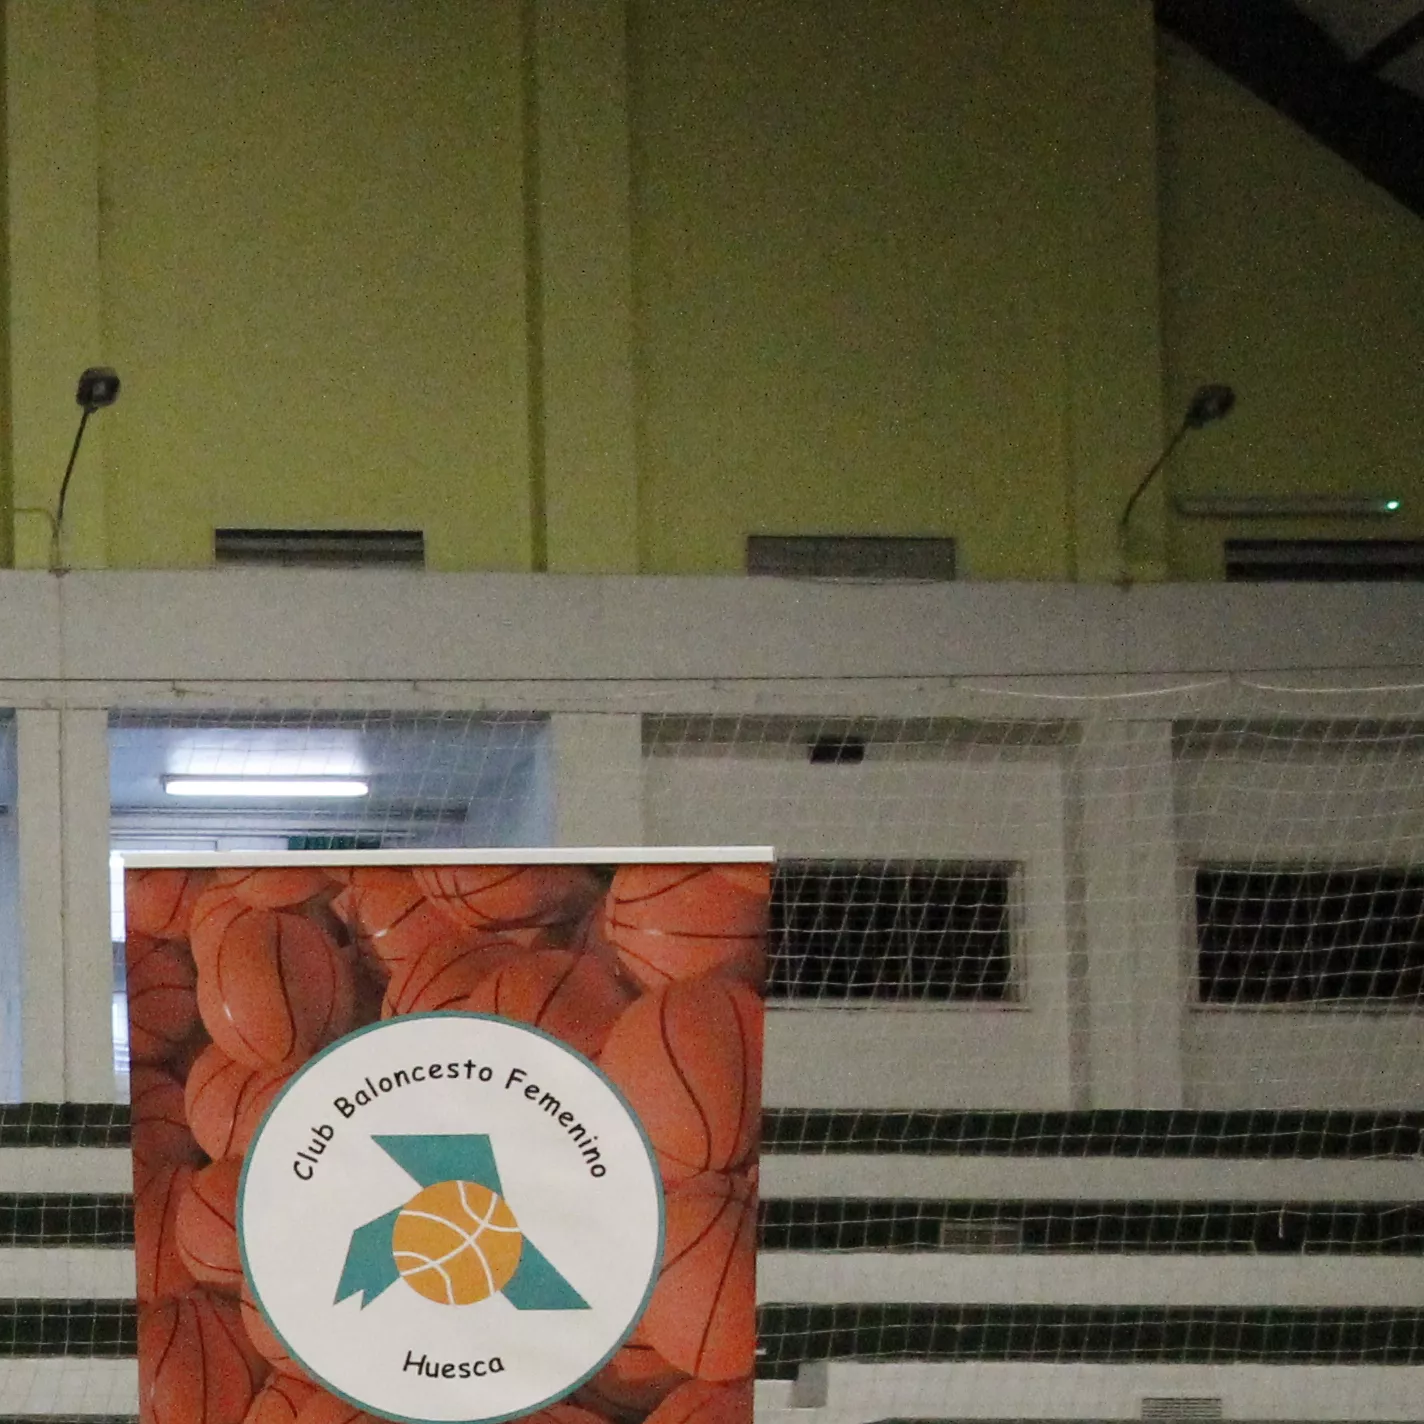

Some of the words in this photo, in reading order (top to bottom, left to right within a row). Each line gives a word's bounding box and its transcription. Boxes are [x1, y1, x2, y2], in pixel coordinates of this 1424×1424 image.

[293, 1124, 334, 1181] Club
[333, 1059, 493, 1119] Baloncesto
[505, 1068, 606, 1178] Femenino
[403, 1350, 504, 1378] Huesca
